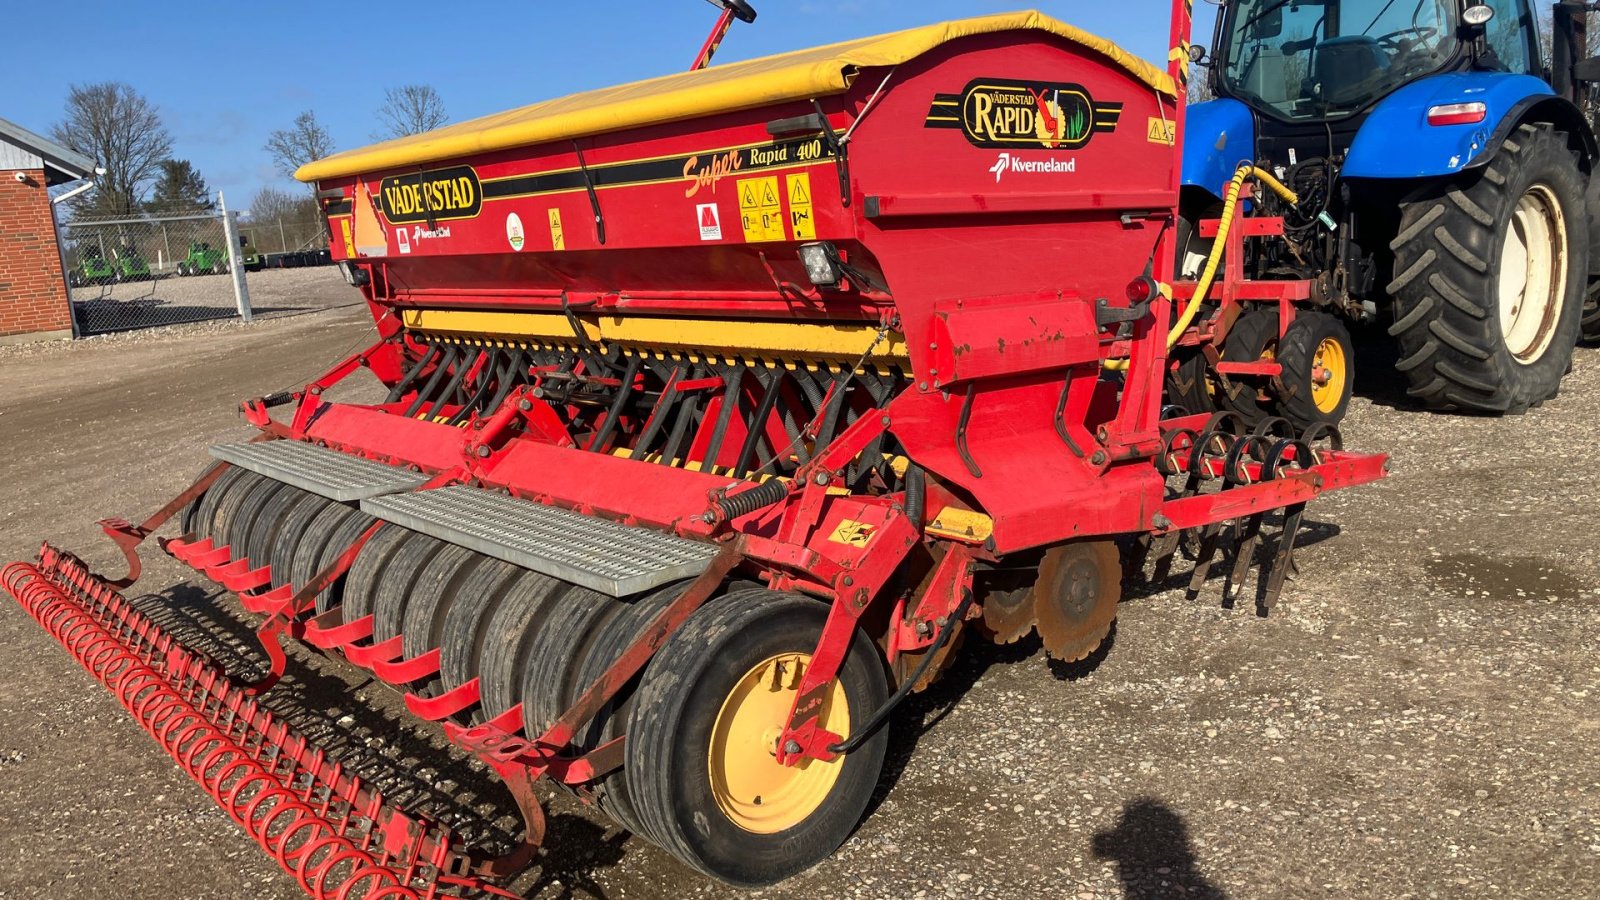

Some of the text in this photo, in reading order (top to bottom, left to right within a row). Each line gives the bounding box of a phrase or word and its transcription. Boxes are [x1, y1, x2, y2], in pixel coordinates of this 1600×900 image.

[974, 92, 1034, 140] RAPID
[990, 92, 1034, 105] VÄDERSTAD
[683, 150, 742, 198] Super
[750, 147, 787, 165] Rapid
[797, 139, 821, 160] 400
[1012, 157, 1075, 173] Kverneland
[385, 177, 474, 215] VÄDERSTAD
